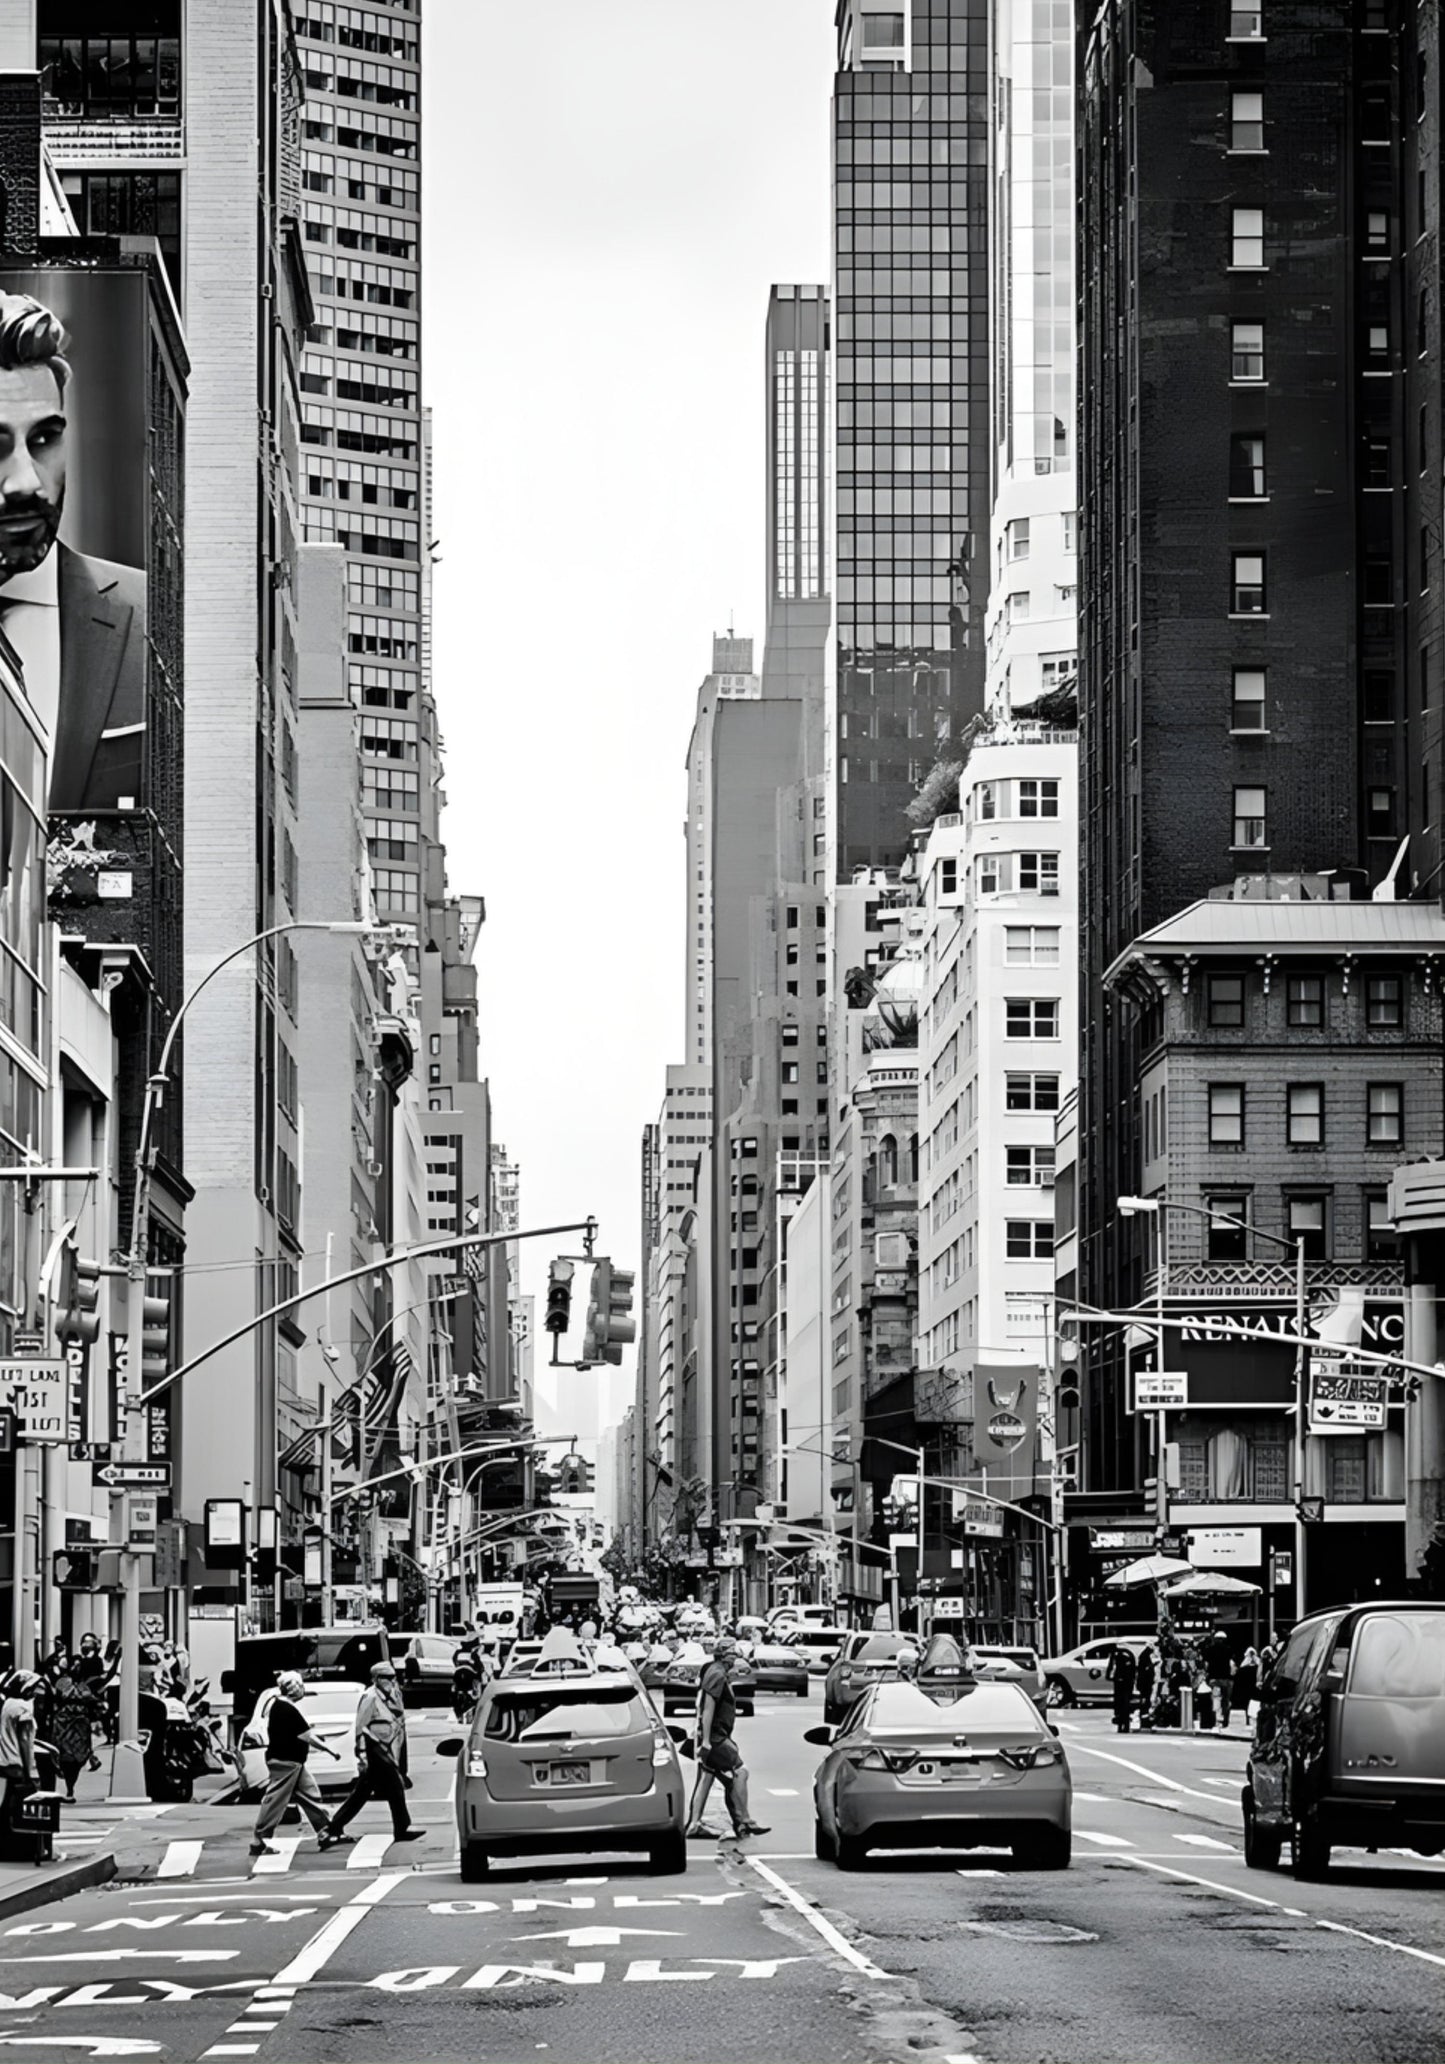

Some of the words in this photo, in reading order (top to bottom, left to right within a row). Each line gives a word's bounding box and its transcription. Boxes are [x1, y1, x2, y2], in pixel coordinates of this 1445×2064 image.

[427, 1891, 750, 1915] ONLY
[3, 1907, 318, 1936] ONLY
[363, 1956, 808, 1992] ONLY
[0, 1979, 271, 2009] NLY
